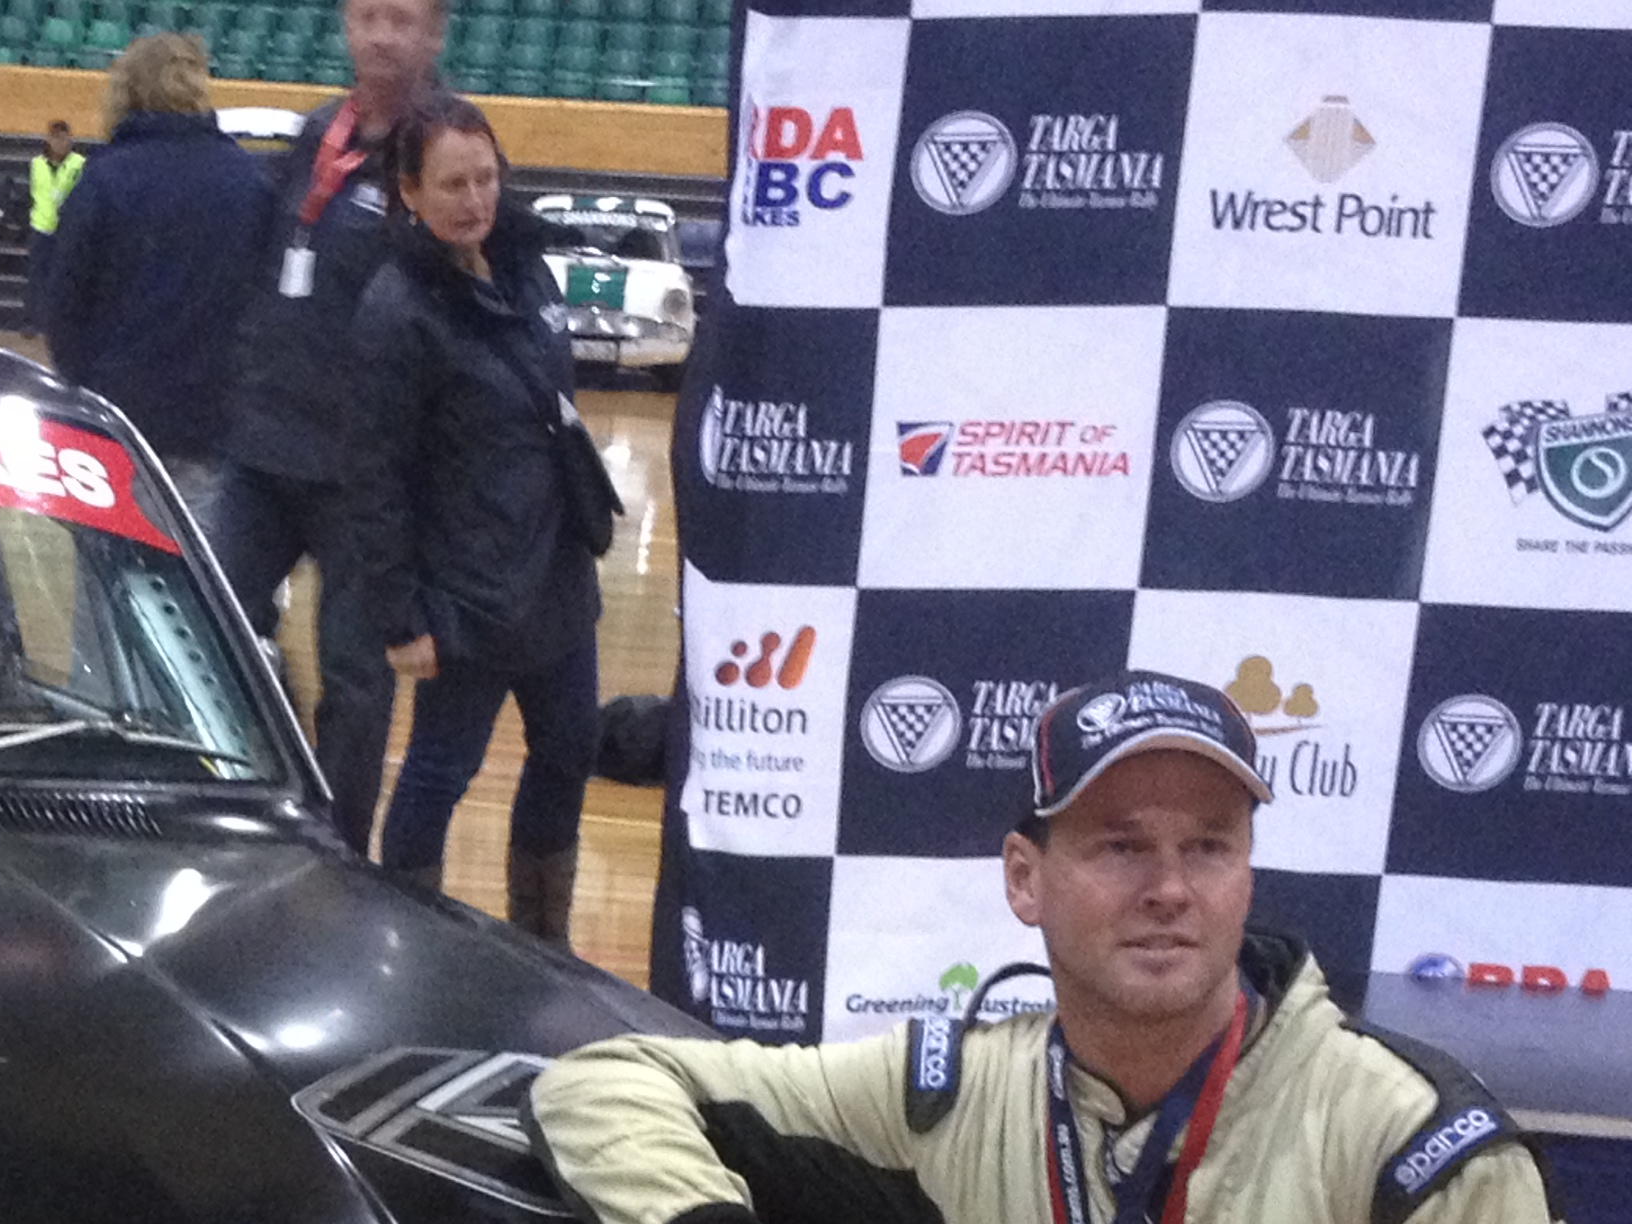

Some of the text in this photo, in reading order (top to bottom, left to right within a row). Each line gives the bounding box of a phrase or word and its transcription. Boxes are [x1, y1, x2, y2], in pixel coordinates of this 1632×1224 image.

[751, 106, 863, 160] DA
[1028, 113, 1119, 151] TARGA
[745, 161, 855, 210] BC
[1021, 151, 1165, 190] TASMANIA
[1209, 188, 1325, 234] Wrest
[1334, 192, 1437, 240] Point
[723, 399, 808, 438] TARGA
[956, 419, 1118, 447] SPIRIT OF
[1285, 406, 1374, 449] TARGA
[718, 436, 854, 475] TASMANIA
[952, 450, 1132, 478] TASMANIA
[1279, 444, 1421, 489] TASMANIA
[1532, 702, 1625, 740] TARGA
[1289, 740, 1358, 798] Club
[702, 788, 803, 820] TEMCO
[708, 938, 766, 978] ARGA
[708, 974, 809, 1014] ASMANIA
[844, 993, 950, 1016] Greening
[1394, 1108, 1499, 1195] sparco
